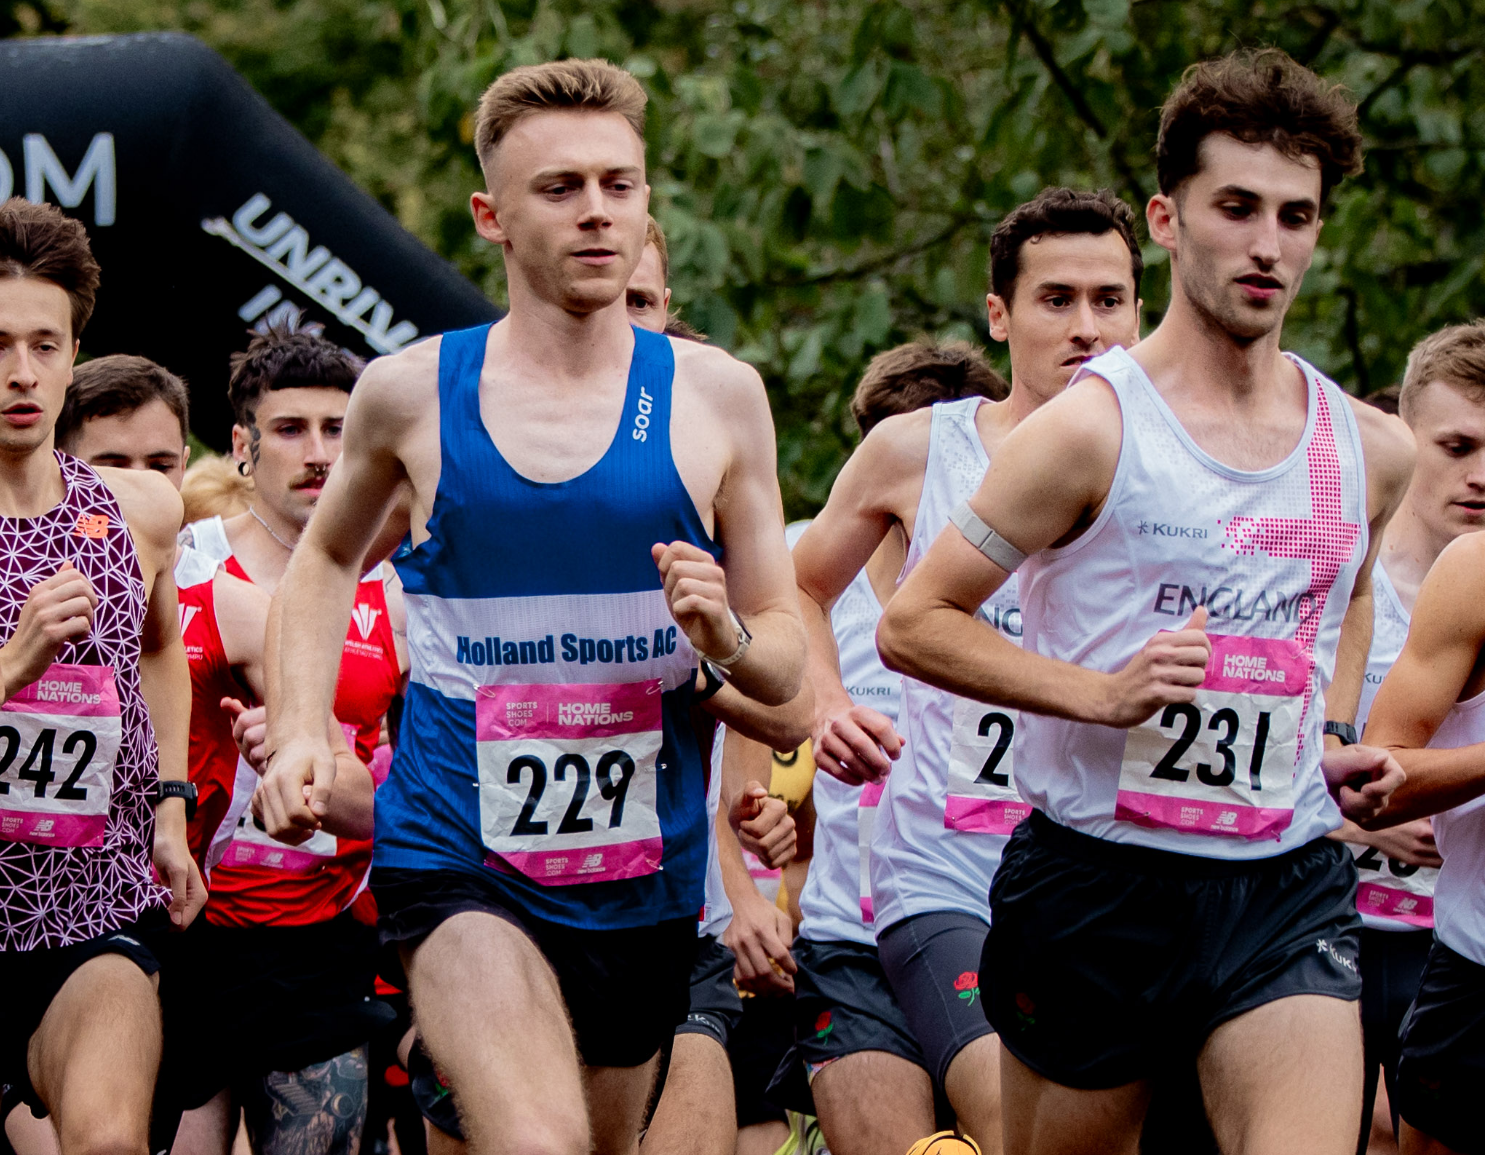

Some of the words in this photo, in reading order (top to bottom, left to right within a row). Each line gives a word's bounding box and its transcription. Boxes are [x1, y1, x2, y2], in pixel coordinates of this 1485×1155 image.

[232, 192, 419, 355] UNRIV
[632, 386, 654, 443] soar
[1152, 522, 1208, 539] KUKRI
[1153, 583, 1316, 624] ENGLAND
[456, 635, 555, 666] Holland
[560, 633, 649, 665] Sports
[652, 625, 677, 659] AC
[1224, 654, 1267, 670] HOME
[1222, 666, 1285, 683] NATIONS
[38, 679, 82, 693] HOME
[846, 686, 891, 697] KUKRI
[36, 690, 102, 704] NATIONS
[505, 701, 538, 710] SPORTS
[558, 702, 611, 714] HOME
[505, 710, 533, 718] SHOES
[558, 710, 634, 726] NATIONS
[1149, 702, 1271, 791] 231
[506, 749, 636, 837] 229
